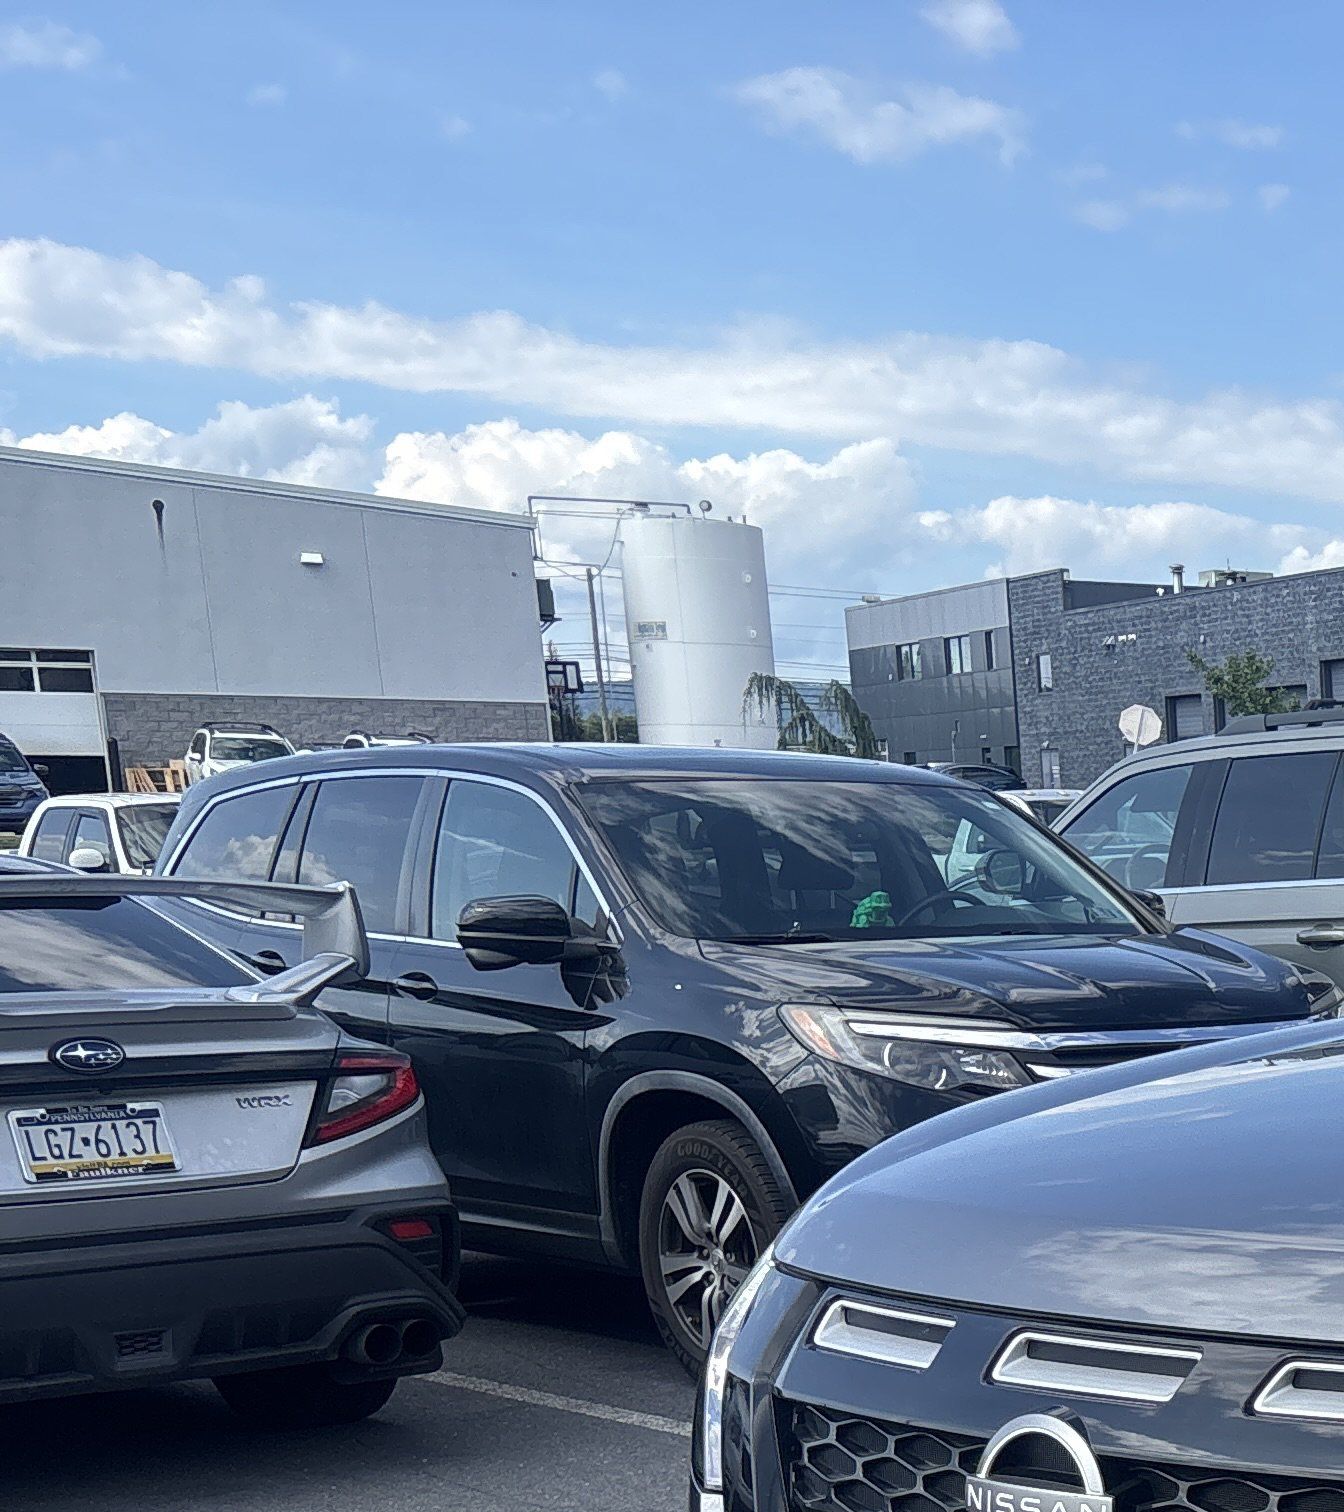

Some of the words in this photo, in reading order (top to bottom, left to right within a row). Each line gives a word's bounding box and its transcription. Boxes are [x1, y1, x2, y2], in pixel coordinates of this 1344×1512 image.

[235, 1094, 293, 1109] WRX
[51, 1110, 128, 1123] PENNSYLVANIA
[67, 1165, 145, 1179] Faulkner
